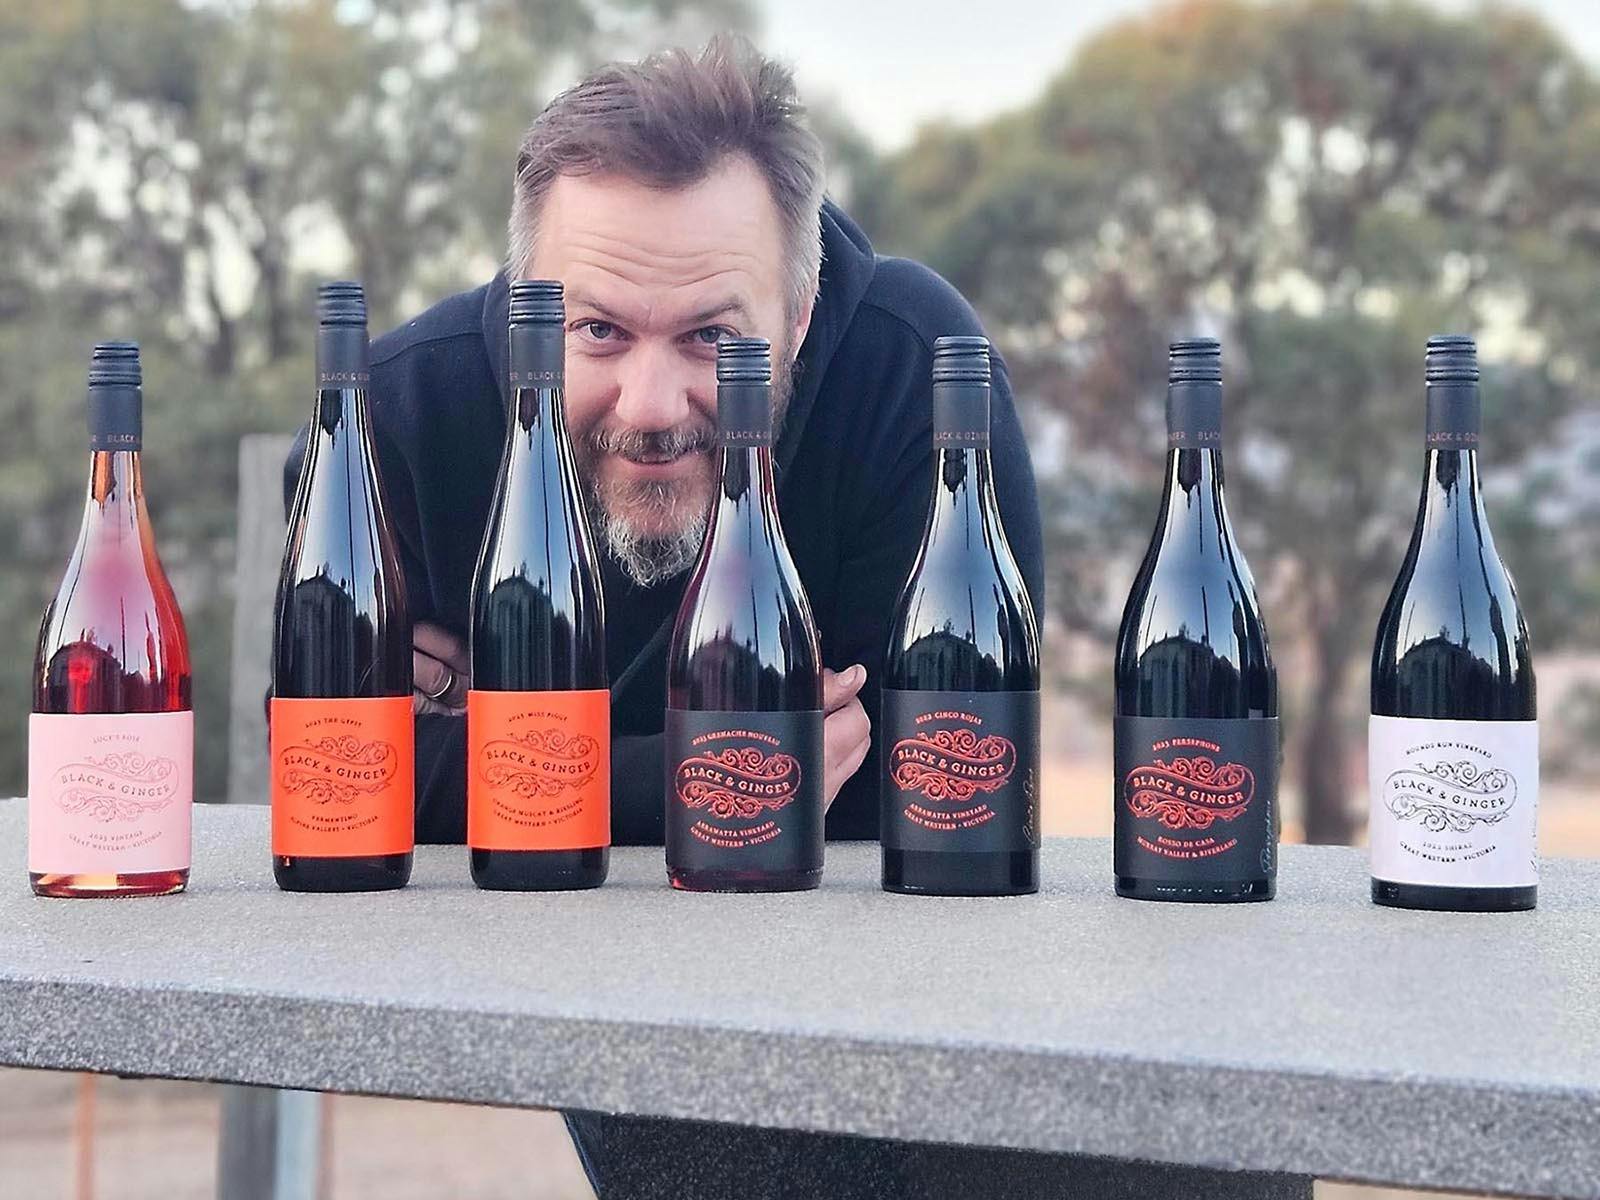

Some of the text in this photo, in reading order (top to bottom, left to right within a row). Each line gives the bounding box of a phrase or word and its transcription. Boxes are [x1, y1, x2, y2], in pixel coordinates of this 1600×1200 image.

[934, 711, 959, 719] CINCO
[960, 712, 982, 725] ROJAS
[707, 731, 747, 740] GRENACHE
[1172, 738, 1220, 752] PERSEPHONE
[1456, 743, 1492, 758] VINEYARD
[284, 755, 388, 780] BLACK & GINGER
[486, 750, 591, 774] BLACK & GINGER
[898, 748, 1005, 777] BLACK & GINGER
[61, 773, 171, 797] BLACK & GINGER
[684, 768, 790, 794] BLACK & GINGER
[1133, 776, 1244, 805] BLACK & GINGER
[1393, 779, 1506, 809] BLACK & GINGER
[904, 809, 996, 829] GREAT WESTERN VICTORIA
[952, 804, 987, 819] VINEYARD
[690, 826, 782, 847] GREAT WESTERN VICTORIA
[739, 821, 775, 837] VINEYARD
[1137, 836, 1162, 853] MURRAY
[1163, 848, 1190, 858] VALLEY
[1199, 838, 1238, 857] RIVERLAND
[1157, 836, 1182, 847] ROSSO
[1400, 840, 1496, 862] GREAT WESTERN VICTORIA
